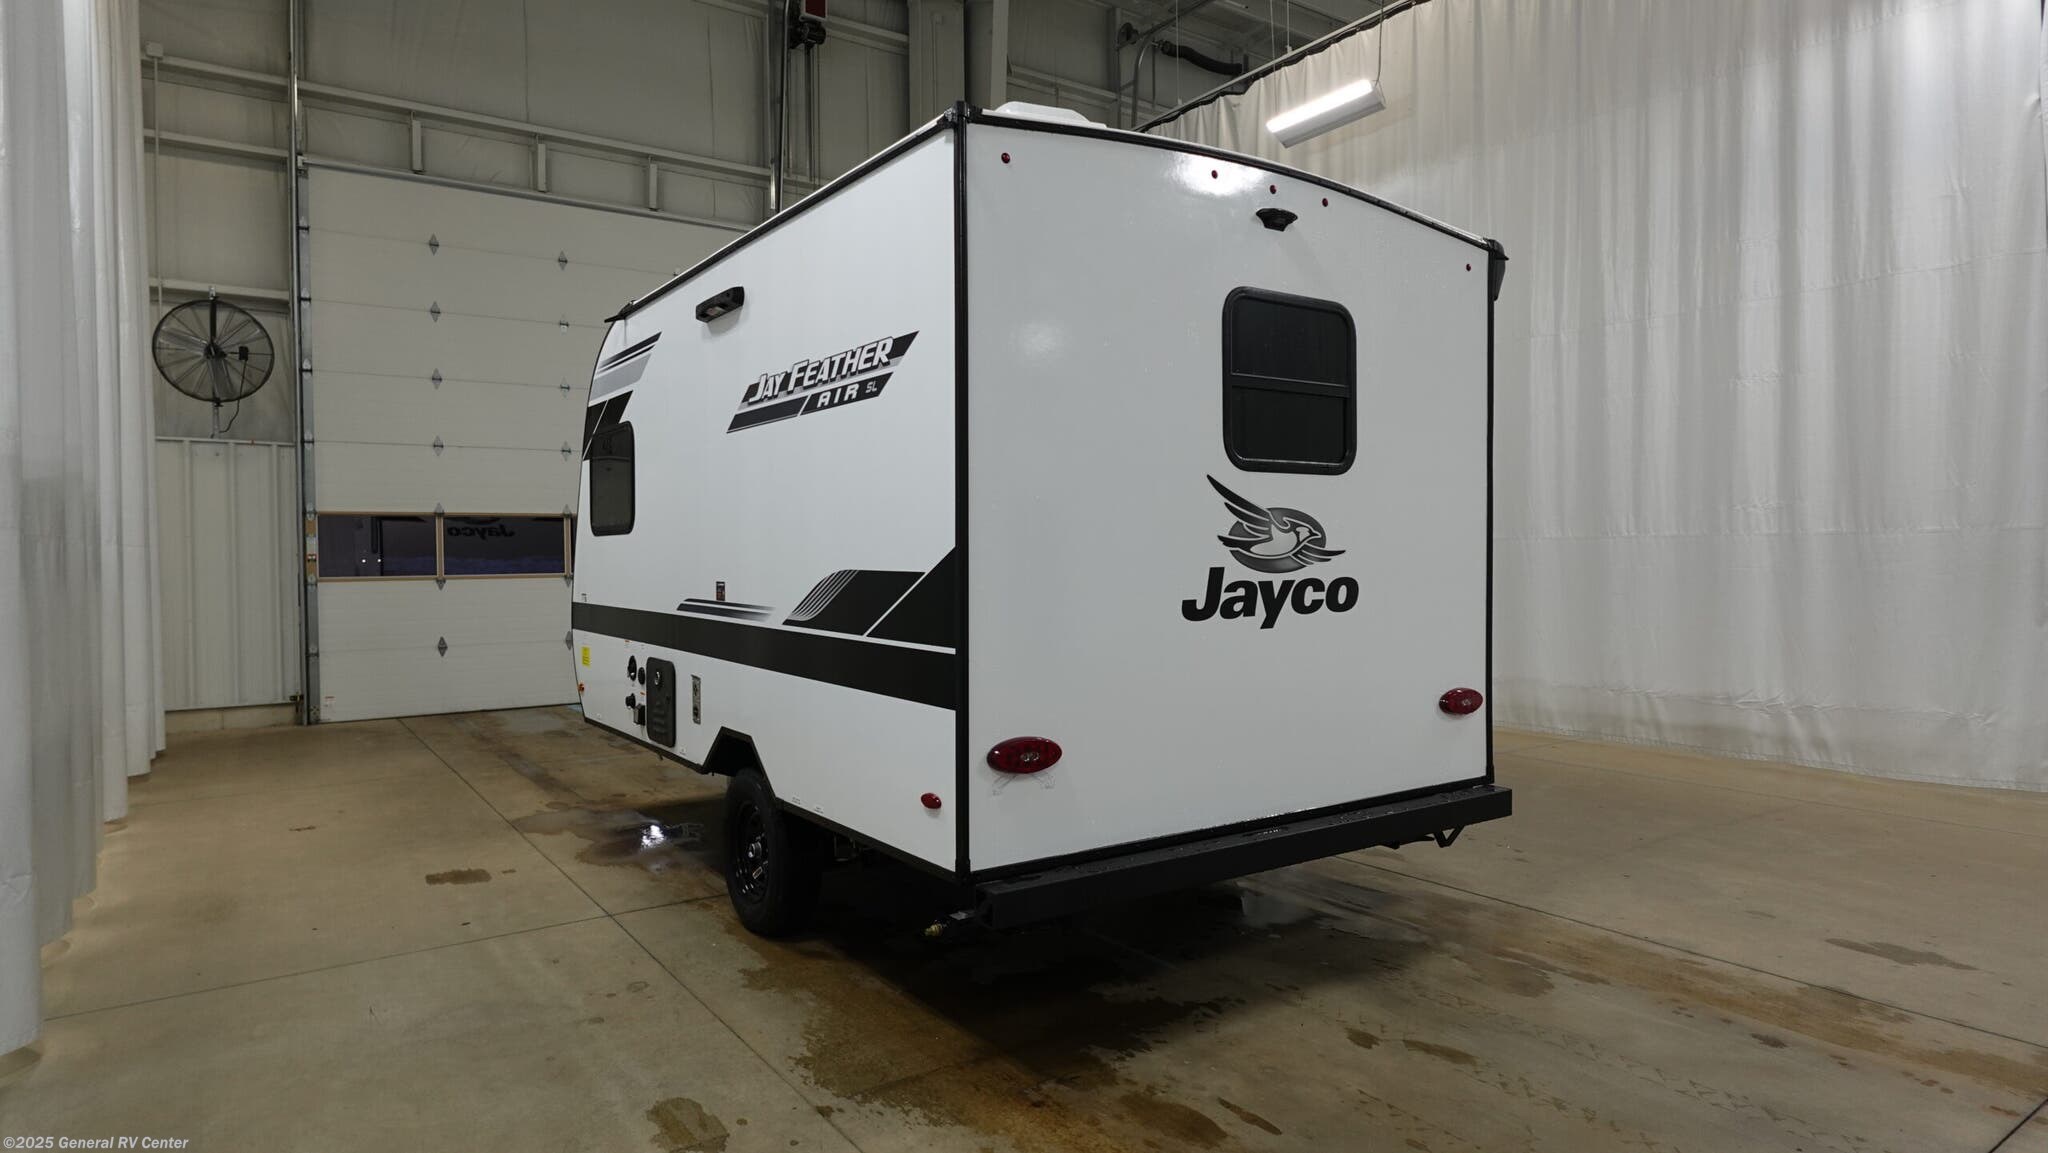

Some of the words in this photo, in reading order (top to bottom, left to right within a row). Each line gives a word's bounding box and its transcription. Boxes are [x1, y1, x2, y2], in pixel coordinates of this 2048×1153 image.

[748, 373, 787, 404] JAY
[787, 336, 894, 392] FEATHER
[817, 383, 860, 408] AIR
[865, 381, 878, 394] SL
[1181, 566, 1360, 630] Jayco
